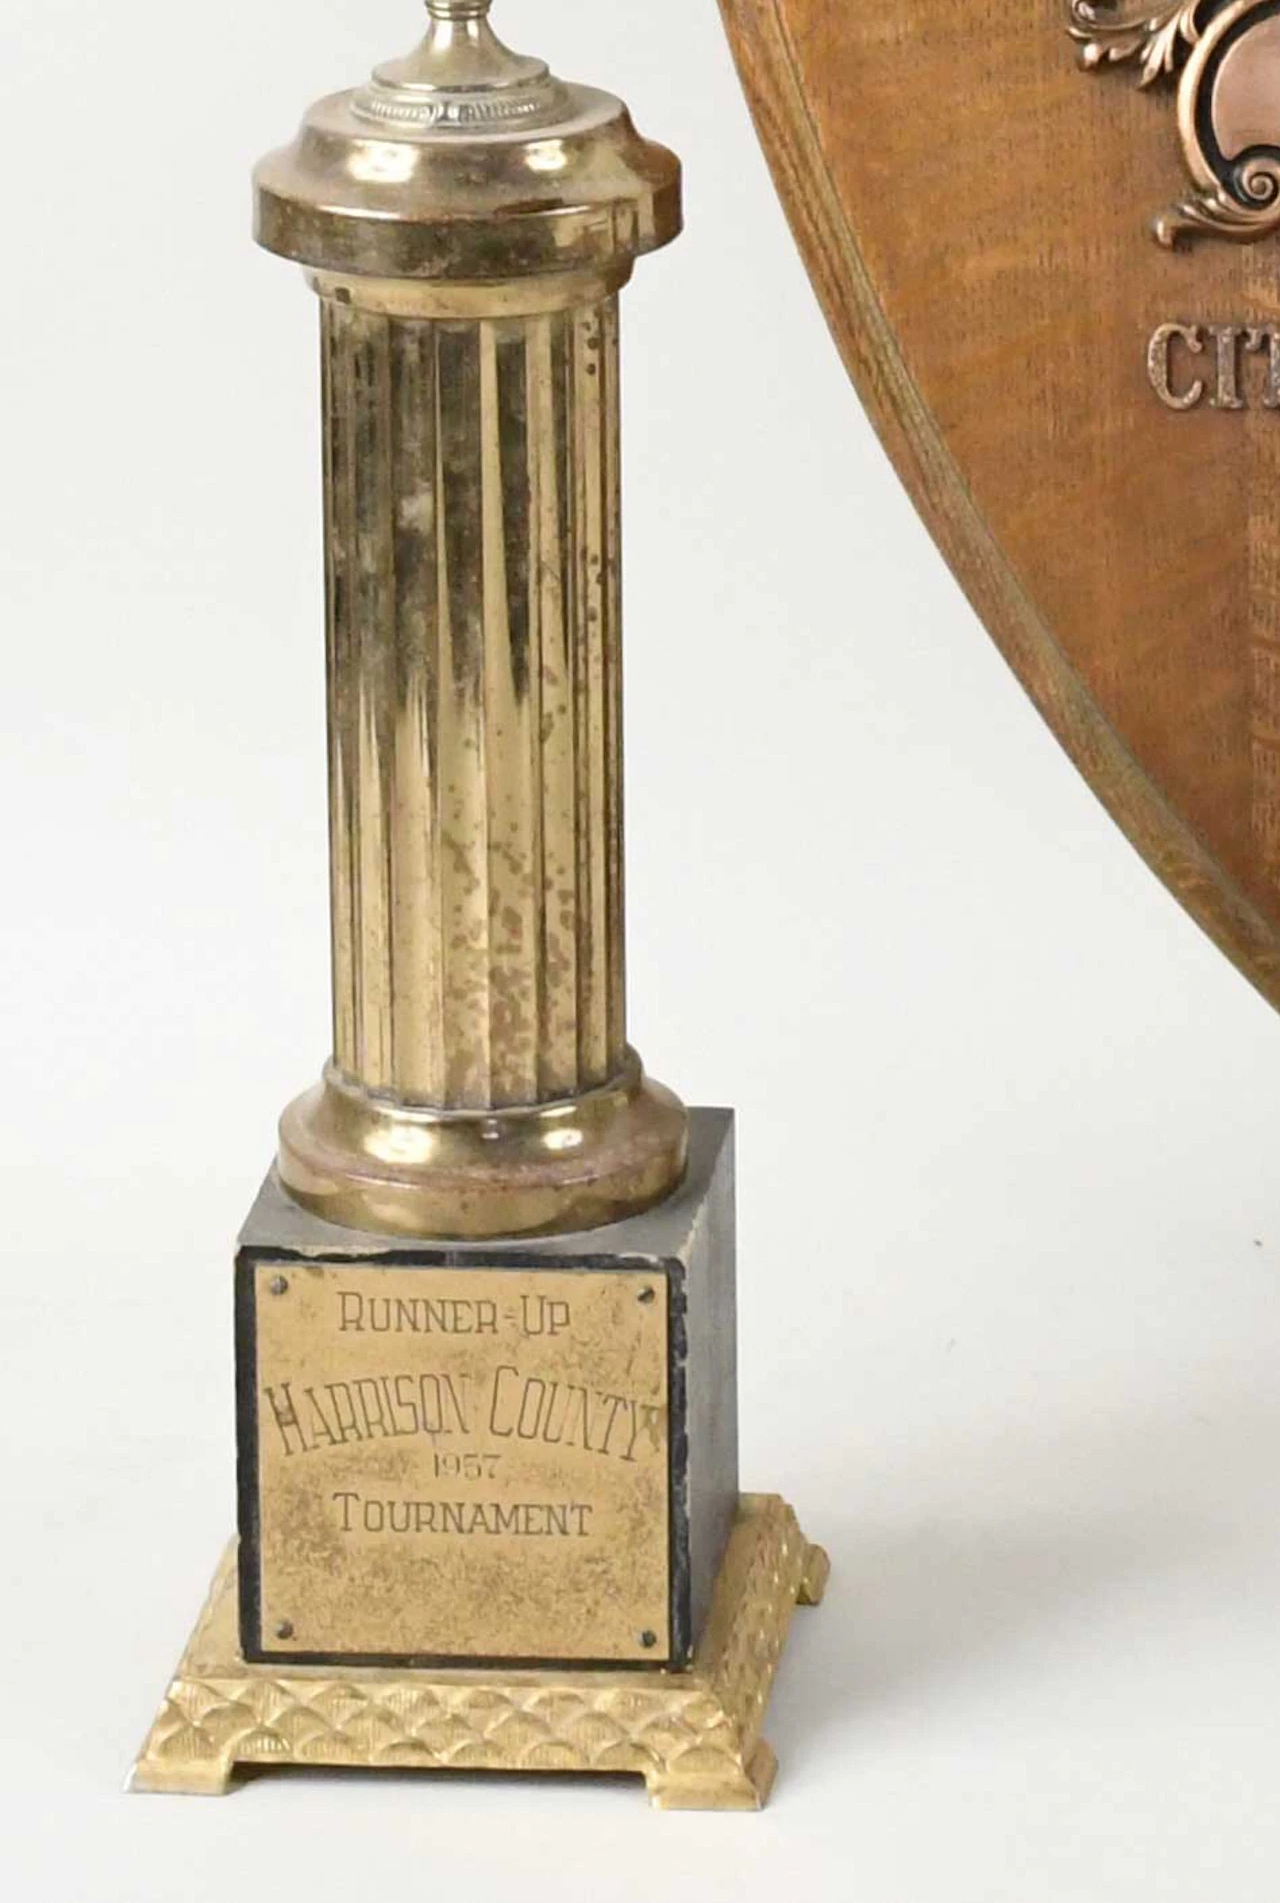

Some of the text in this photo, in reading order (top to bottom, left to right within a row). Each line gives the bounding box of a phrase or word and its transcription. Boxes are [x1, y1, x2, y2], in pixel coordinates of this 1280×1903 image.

[263, 1364, 666, 1462] HARRISON COUNTY
[432, 1453, 502, 1479] 1957
[333, 1491, 593, 1537] TOURNAMENT
